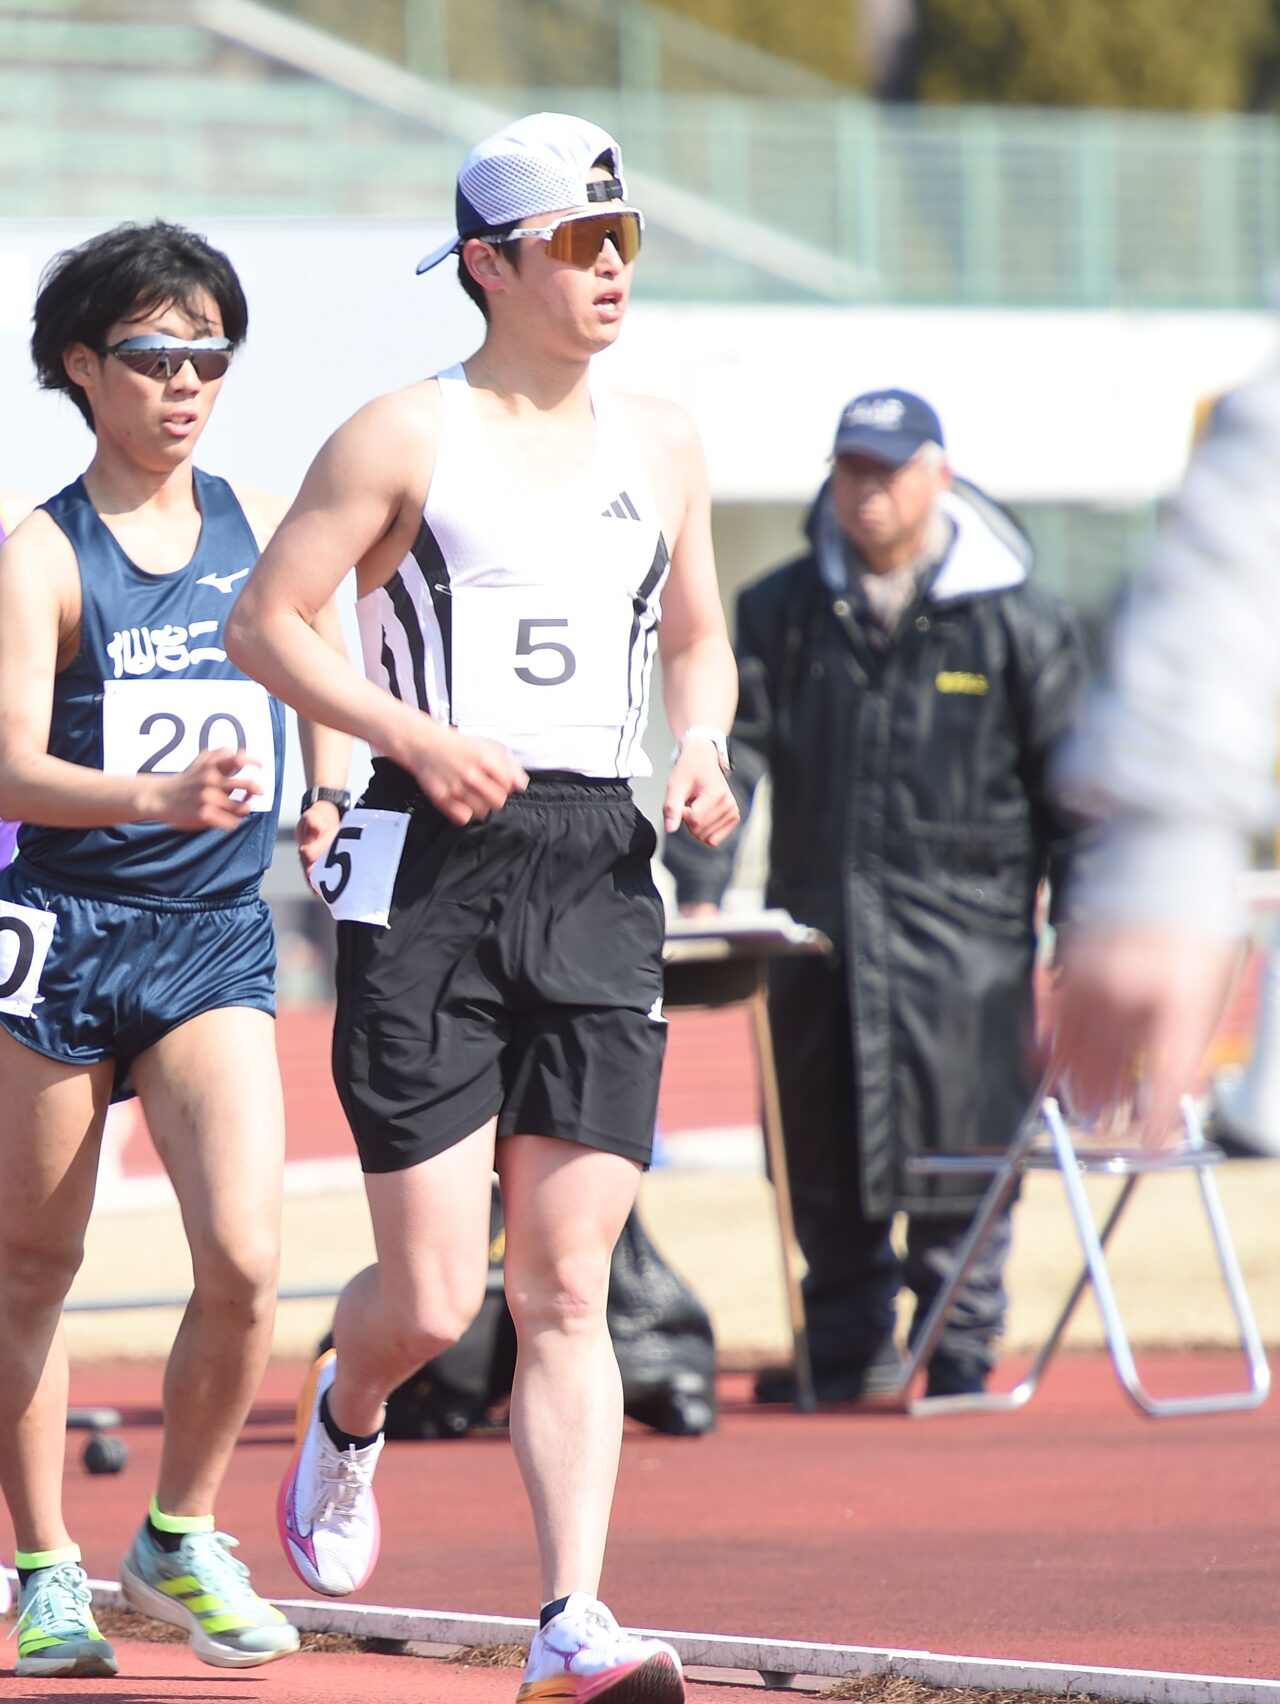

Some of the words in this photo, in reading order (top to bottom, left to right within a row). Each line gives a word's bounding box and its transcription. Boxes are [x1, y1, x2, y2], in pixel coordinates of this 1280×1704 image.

[107, 620, 228, 678] 仙台二
[514, 618, 576, 686] 5
[136, 712, 247, 779] 20
[319, 826, 364, 905] 5
